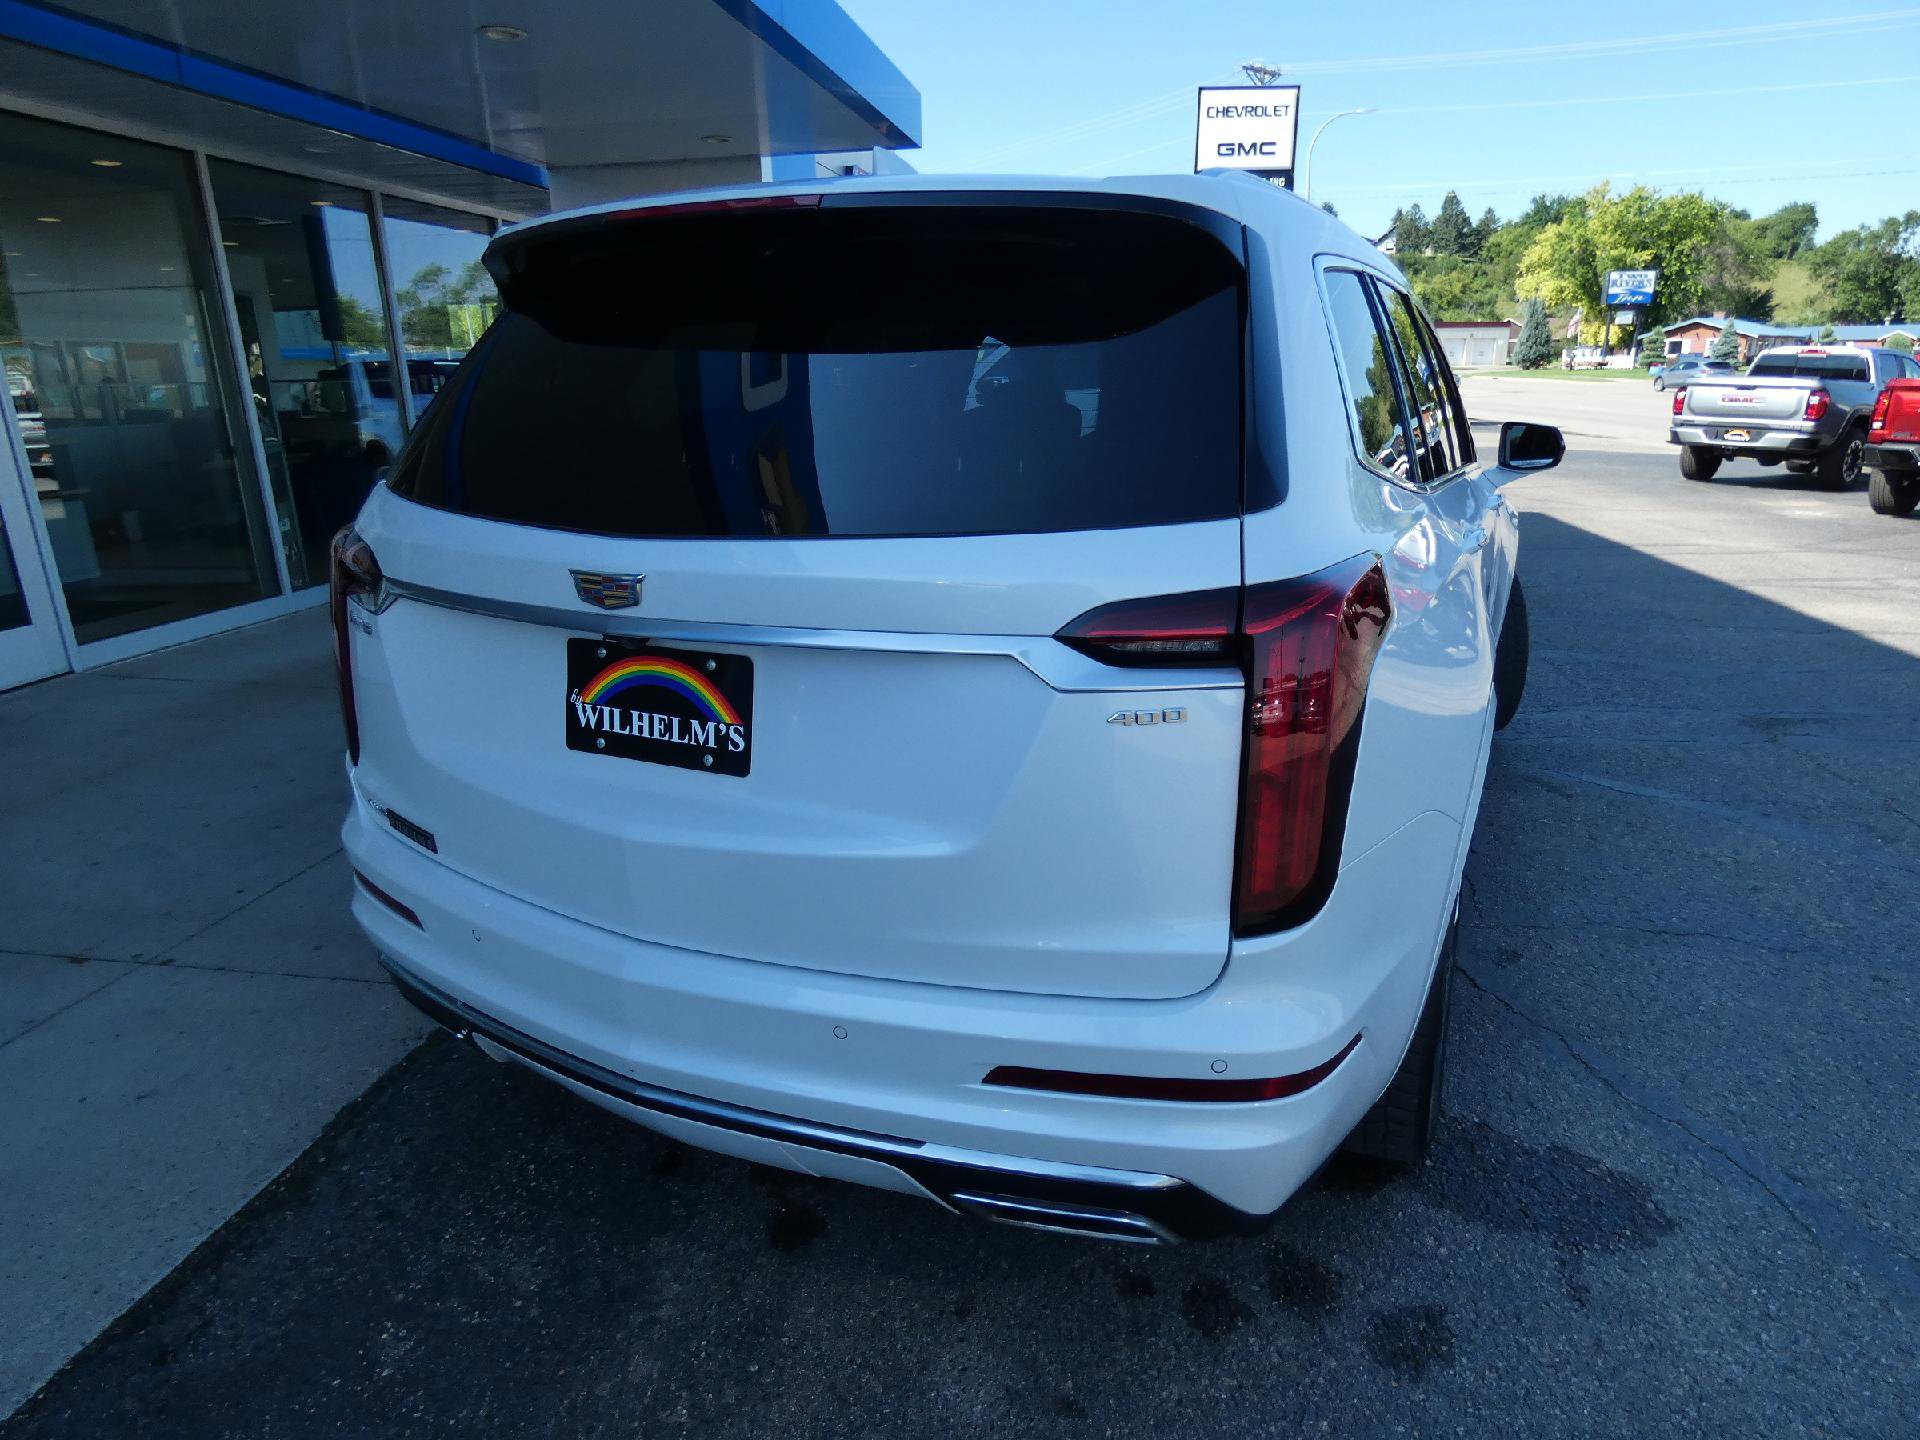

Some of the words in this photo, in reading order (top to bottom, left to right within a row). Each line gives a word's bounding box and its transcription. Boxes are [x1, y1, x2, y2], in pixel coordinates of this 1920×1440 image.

[1206, 105, 1290, 119] CHEVROLET
[1217, 141, 1277, 157] GMC
[1610, 279, 1653, 288] RIVERS
[1618, 272, 1649, 280] TWO
[1721, 395, 1765, 404] GMC
[570, 688, 584, 705] by
[1106, 707, 1188, 726] 400
[576, 702, 746, 752] WILHELM'S
